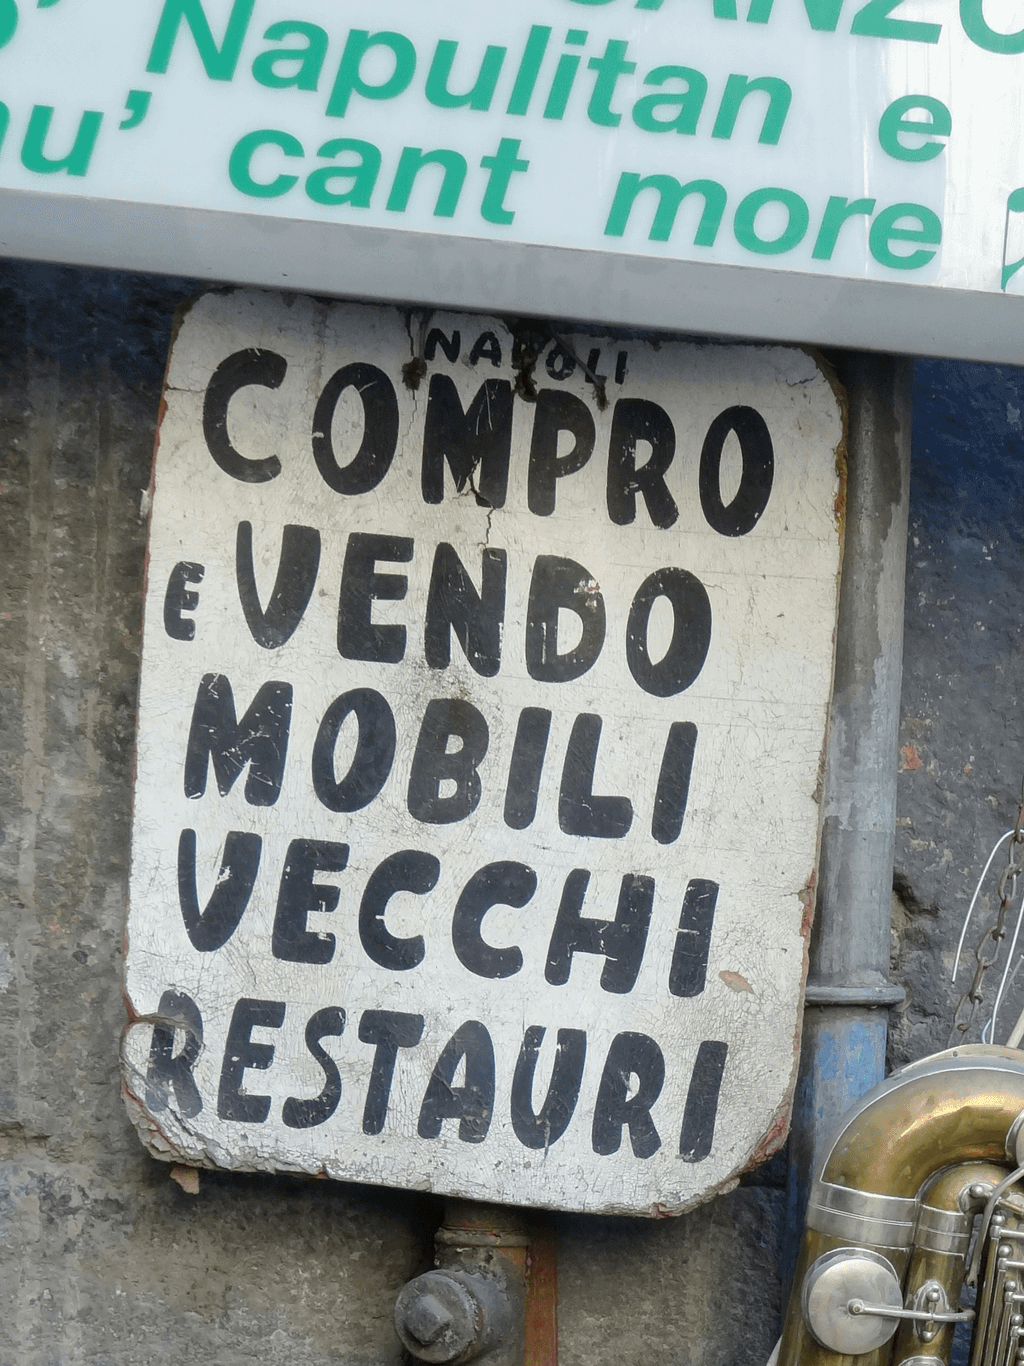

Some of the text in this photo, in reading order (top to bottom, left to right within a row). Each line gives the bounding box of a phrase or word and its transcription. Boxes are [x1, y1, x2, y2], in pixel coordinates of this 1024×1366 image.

[146, 0, 793, 146] Napulitan
[879, 94, 952, 163] e
[228, 128, 530, 226] cant
[603, 170, 943, 271] more
[202, 347, 775, 538] COMPRO
[163, 520, 712, 699] E VENDO
[183, 671, 698, 845] MOBILI
[177, 827, 720, 998] VECCHI
[144, 988, 729, 1164] RESTAURI
